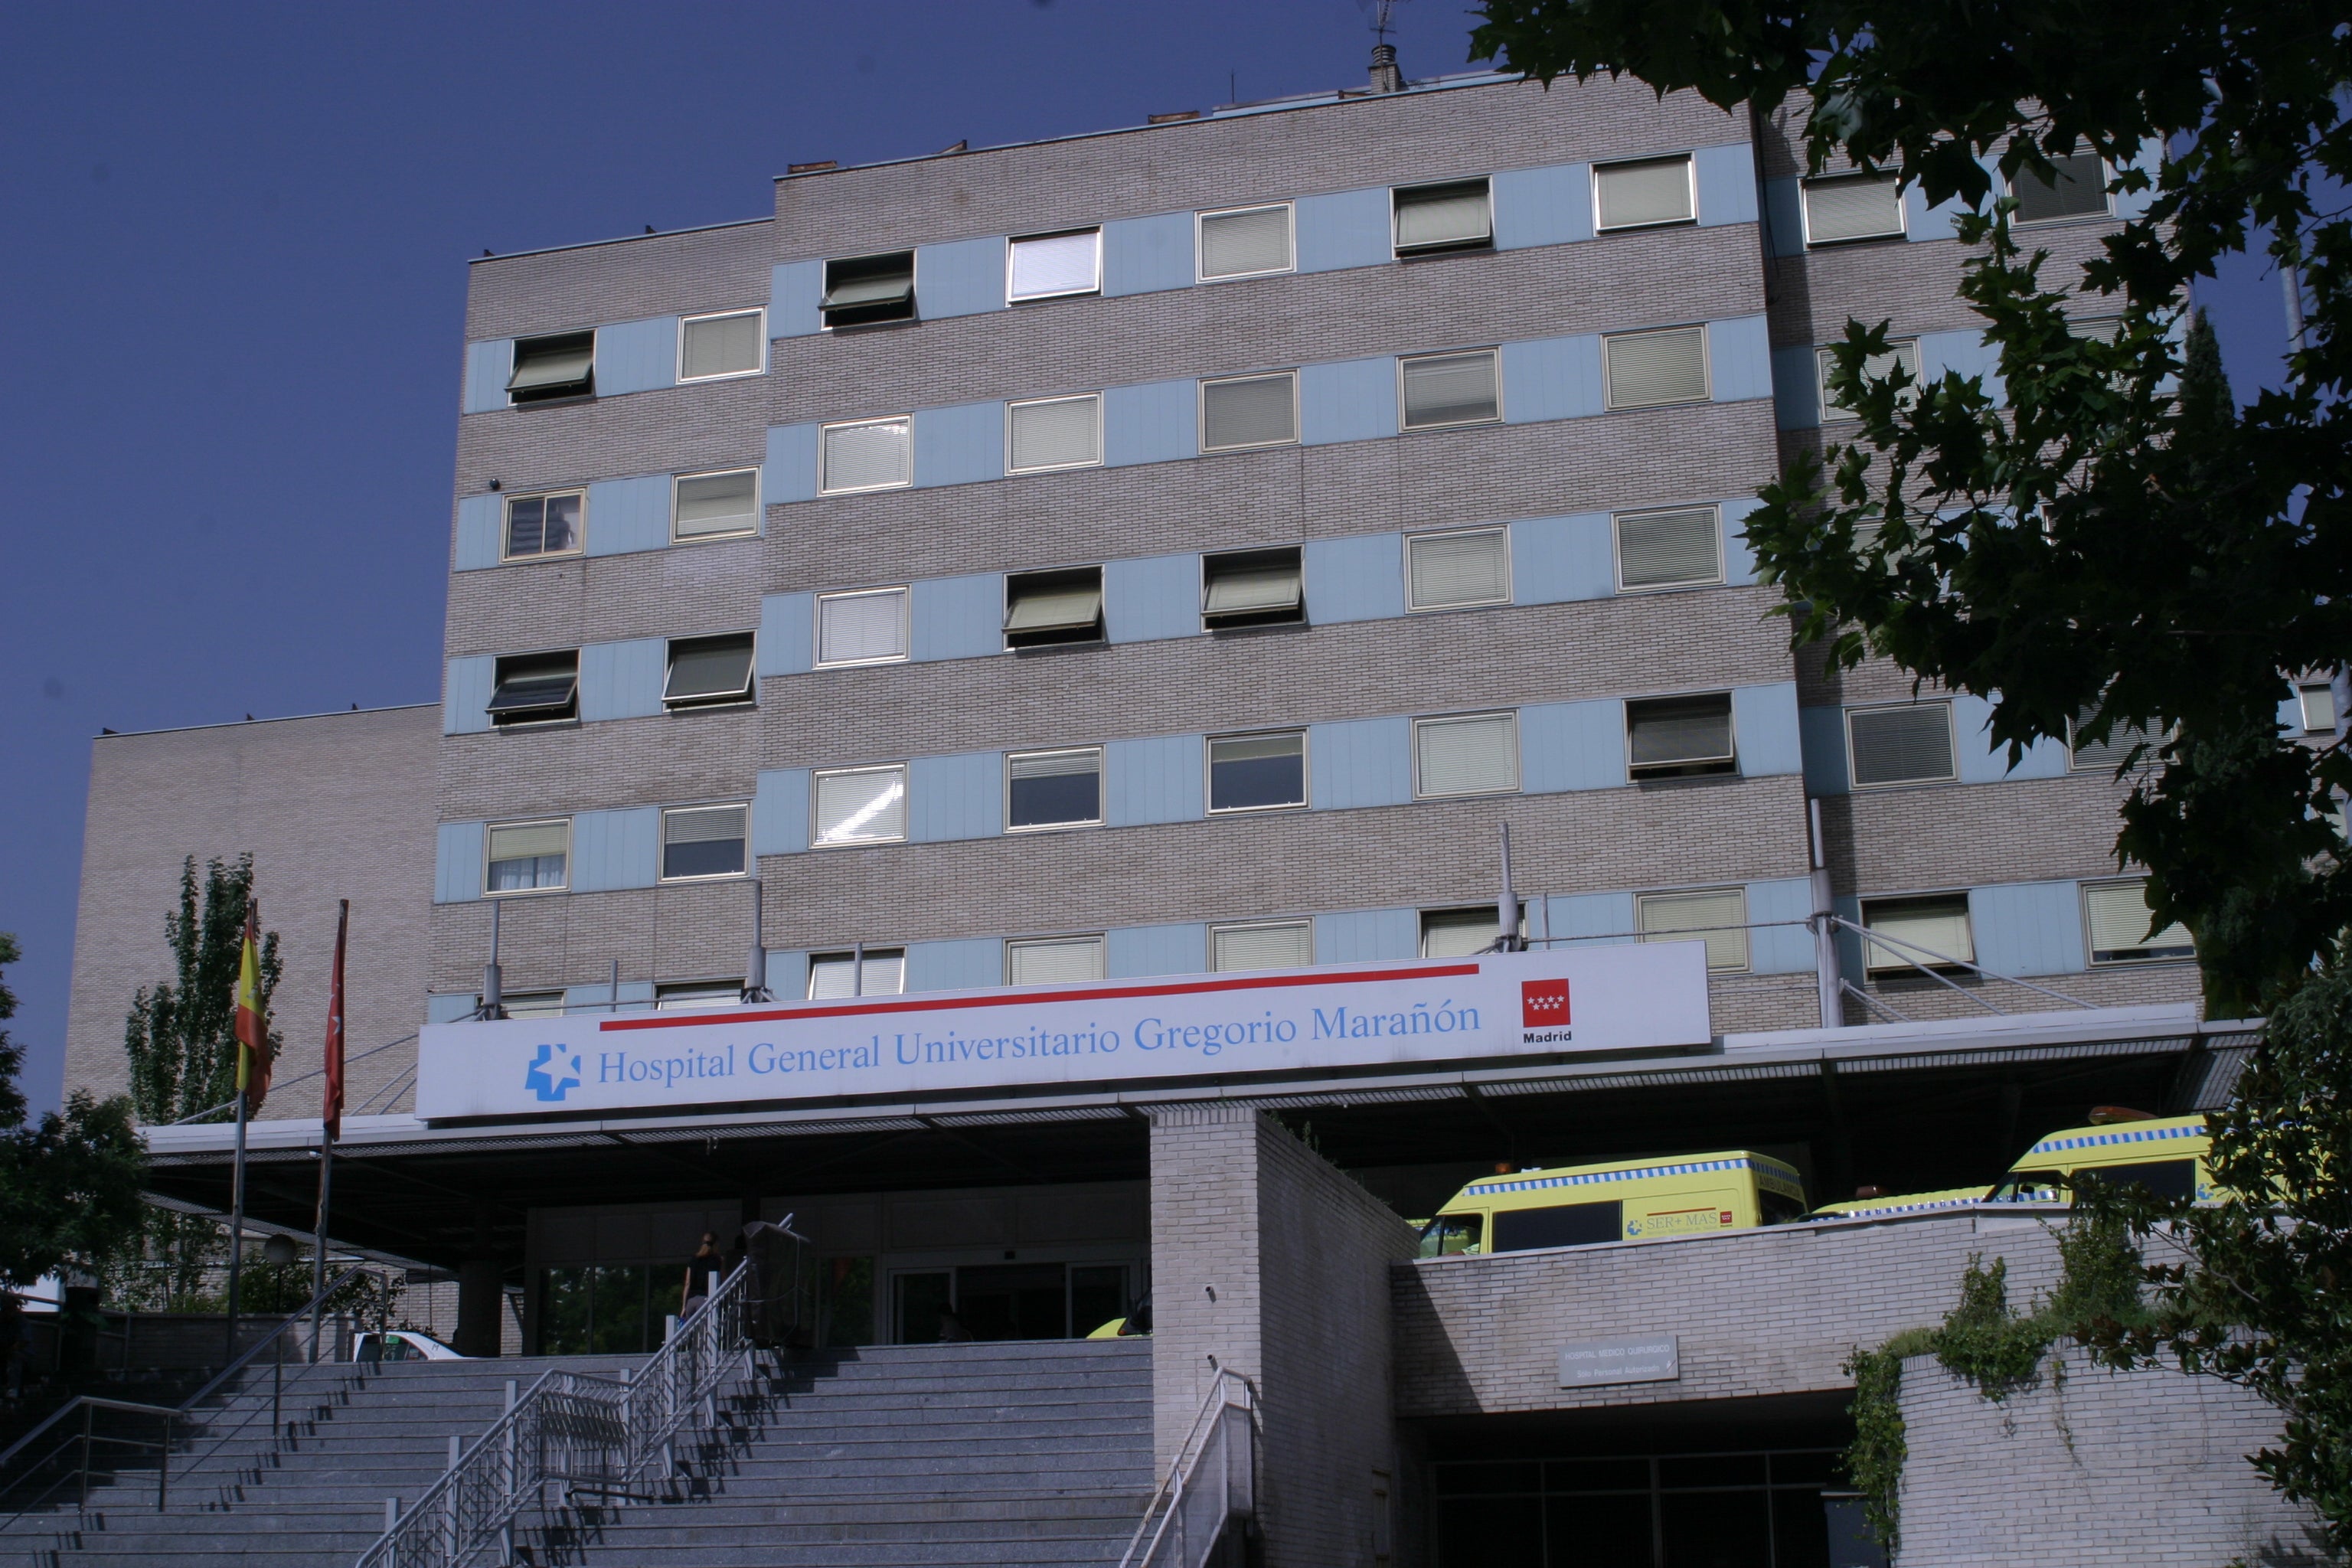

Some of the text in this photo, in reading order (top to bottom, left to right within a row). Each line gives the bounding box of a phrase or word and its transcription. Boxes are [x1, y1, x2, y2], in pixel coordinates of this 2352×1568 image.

[598, 999, 1481, 1089] Hospital General Universitario Gregorio Marañón
[1524, 1031, 1573, 1044] Madrid
[1687, 1213, 1717, 1226] MAS
[1565, 1344, 1670, 1360] HOSPITAL MEDICO QUIRURGICO
[1594, 1367, 1622, 1376] Personal
[1625, 1364, 1661, 1374] Autorizado
